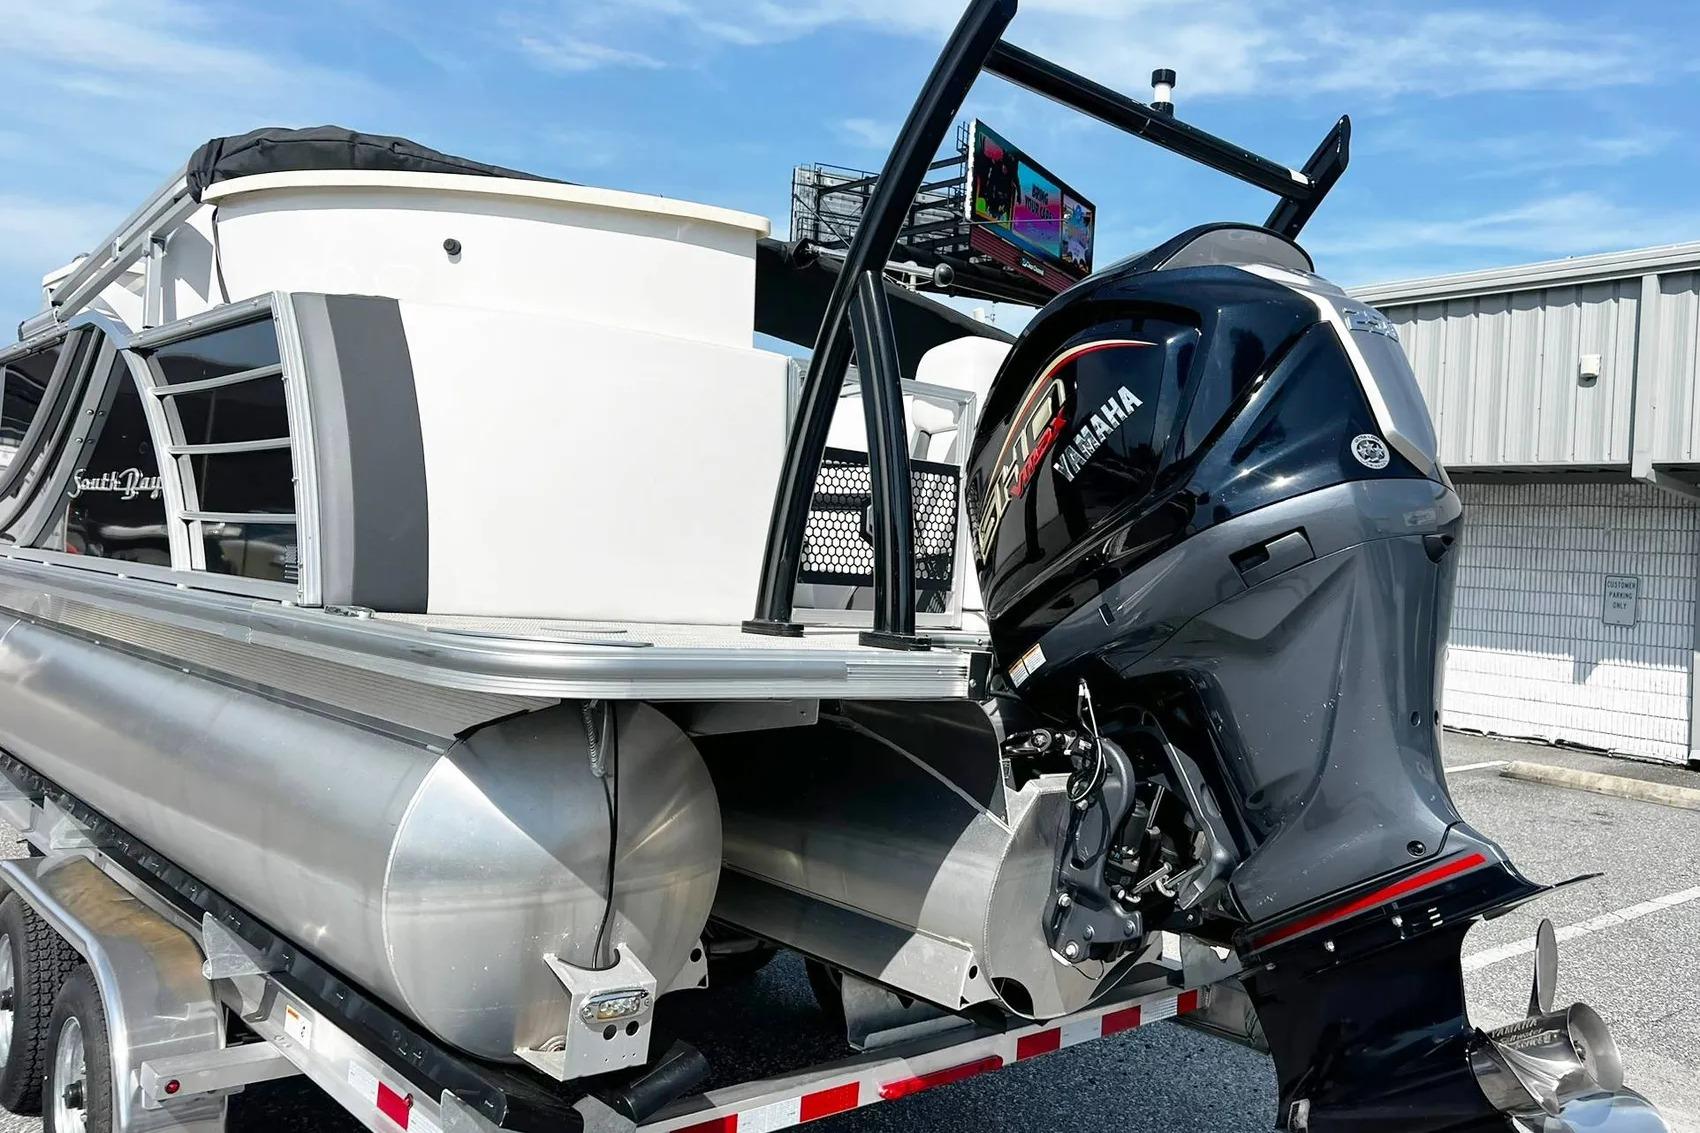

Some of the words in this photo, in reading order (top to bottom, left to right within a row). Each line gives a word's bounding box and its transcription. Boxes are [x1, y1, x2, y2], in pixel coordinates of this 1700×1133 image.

[1053, 385, 1143, 483] YAMAHA
[67, 468, 121, 498] South
[119, 467, 163, 500] Bay
[1607, 580, 1636, 590] CUSTOMER
[1609, 591, 1632, 600] PARKING
[1612, 601, 1627, 610] ONLY
[1491, 1018, 1537, 1038] YAMAHA
